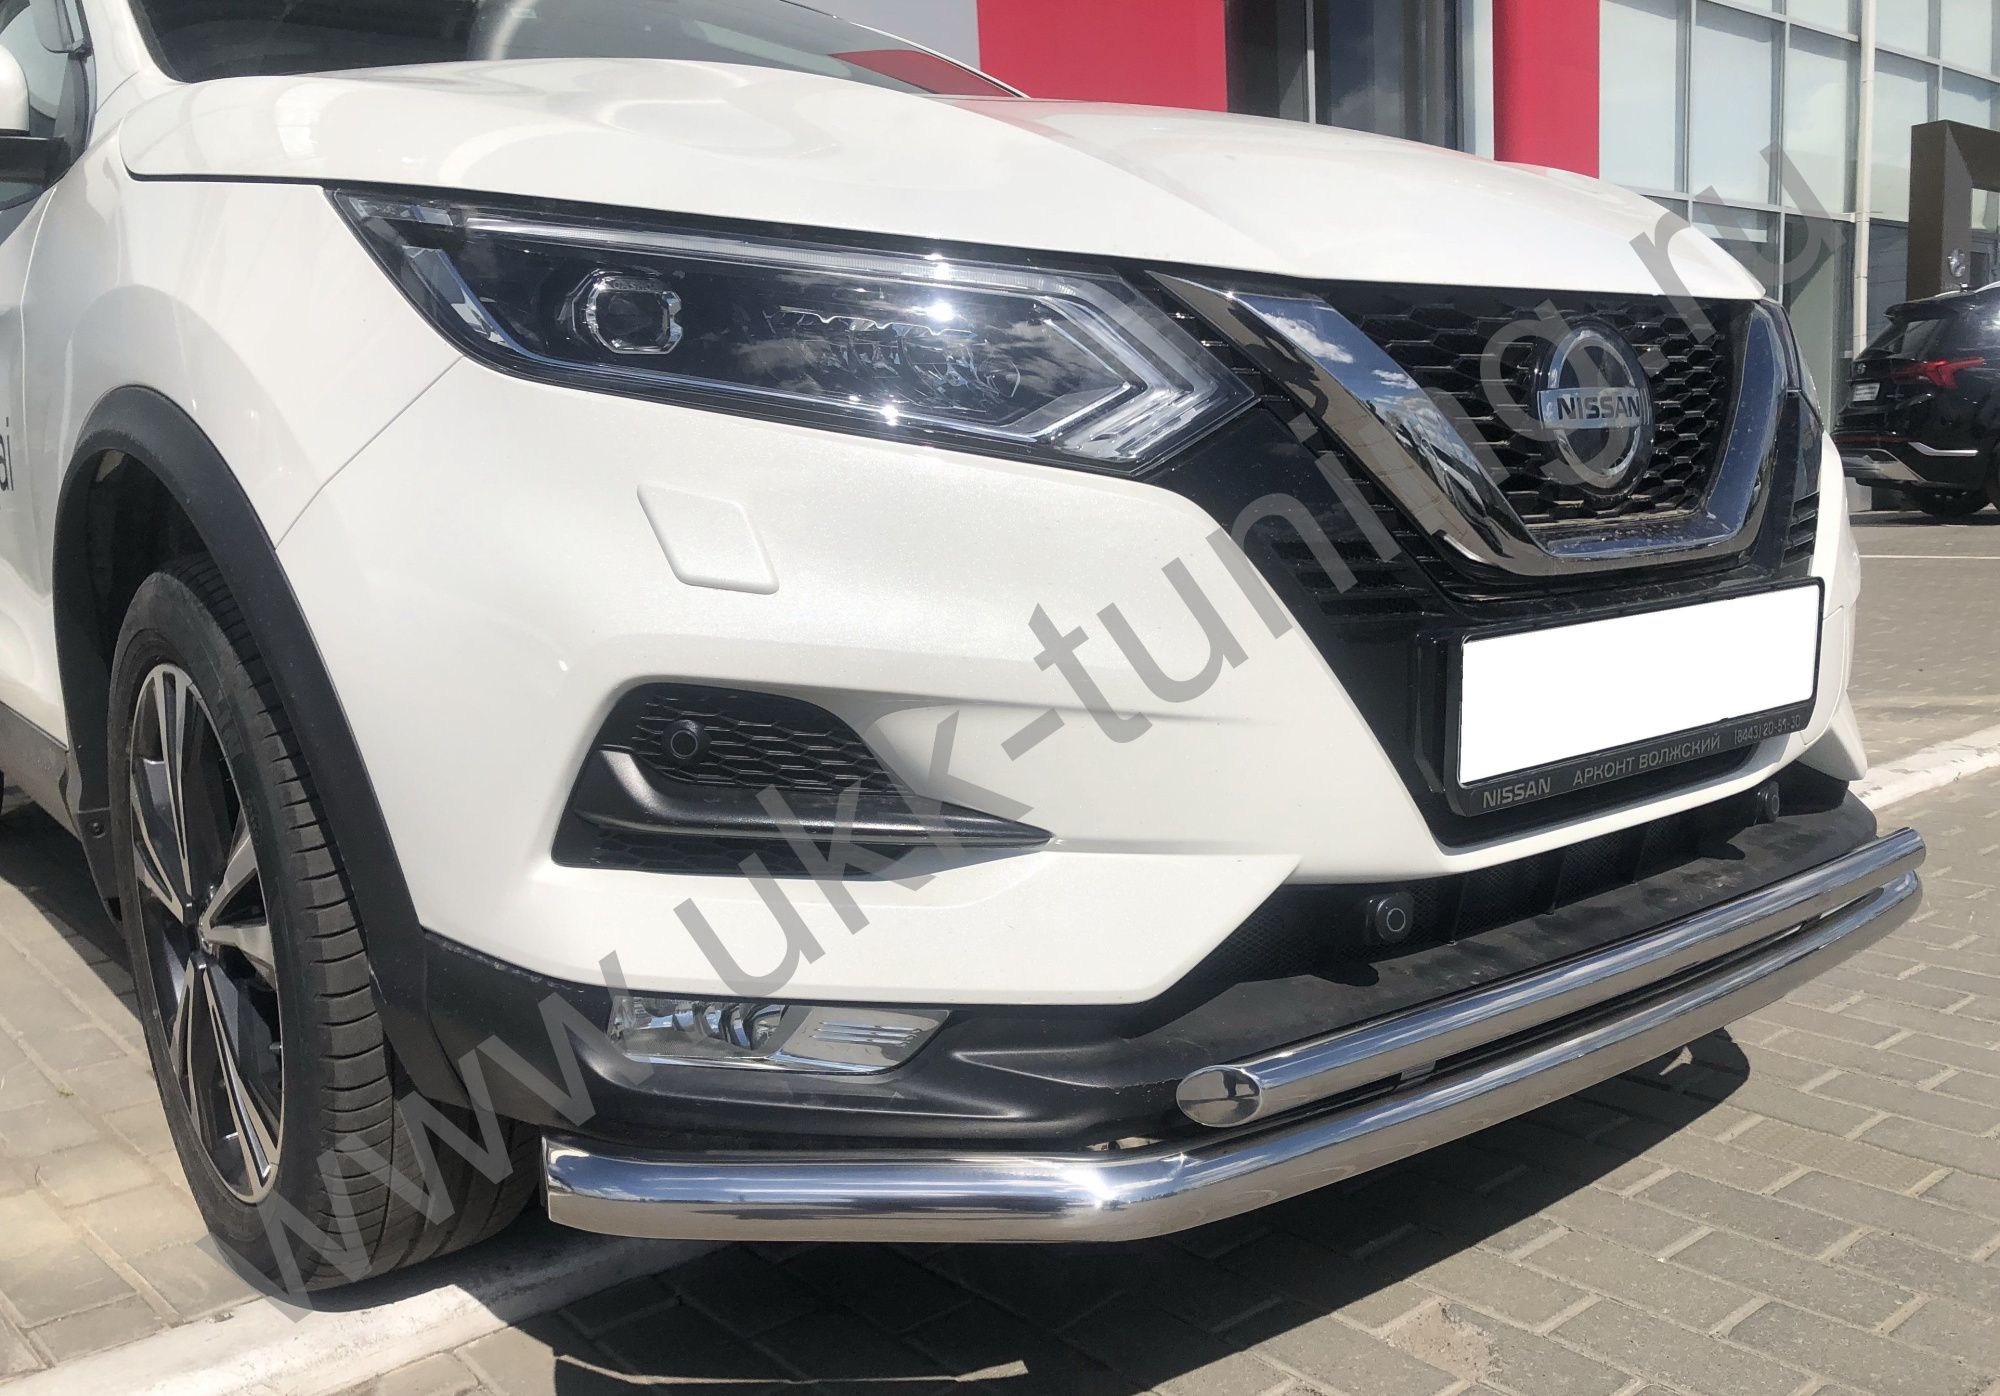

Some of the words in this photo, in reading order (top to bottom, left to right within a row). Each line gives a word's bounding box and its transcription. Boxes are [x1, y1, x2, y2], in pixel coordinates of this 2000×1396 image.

[1557, 396, 1640, 420] NISSAN
[1572, 758, 1635, 787] АРКОНТ
[1639, 734, 1721, 770] ВОЛЖСКИЙ
[1483, 777, 1551, 808] NISSAN
